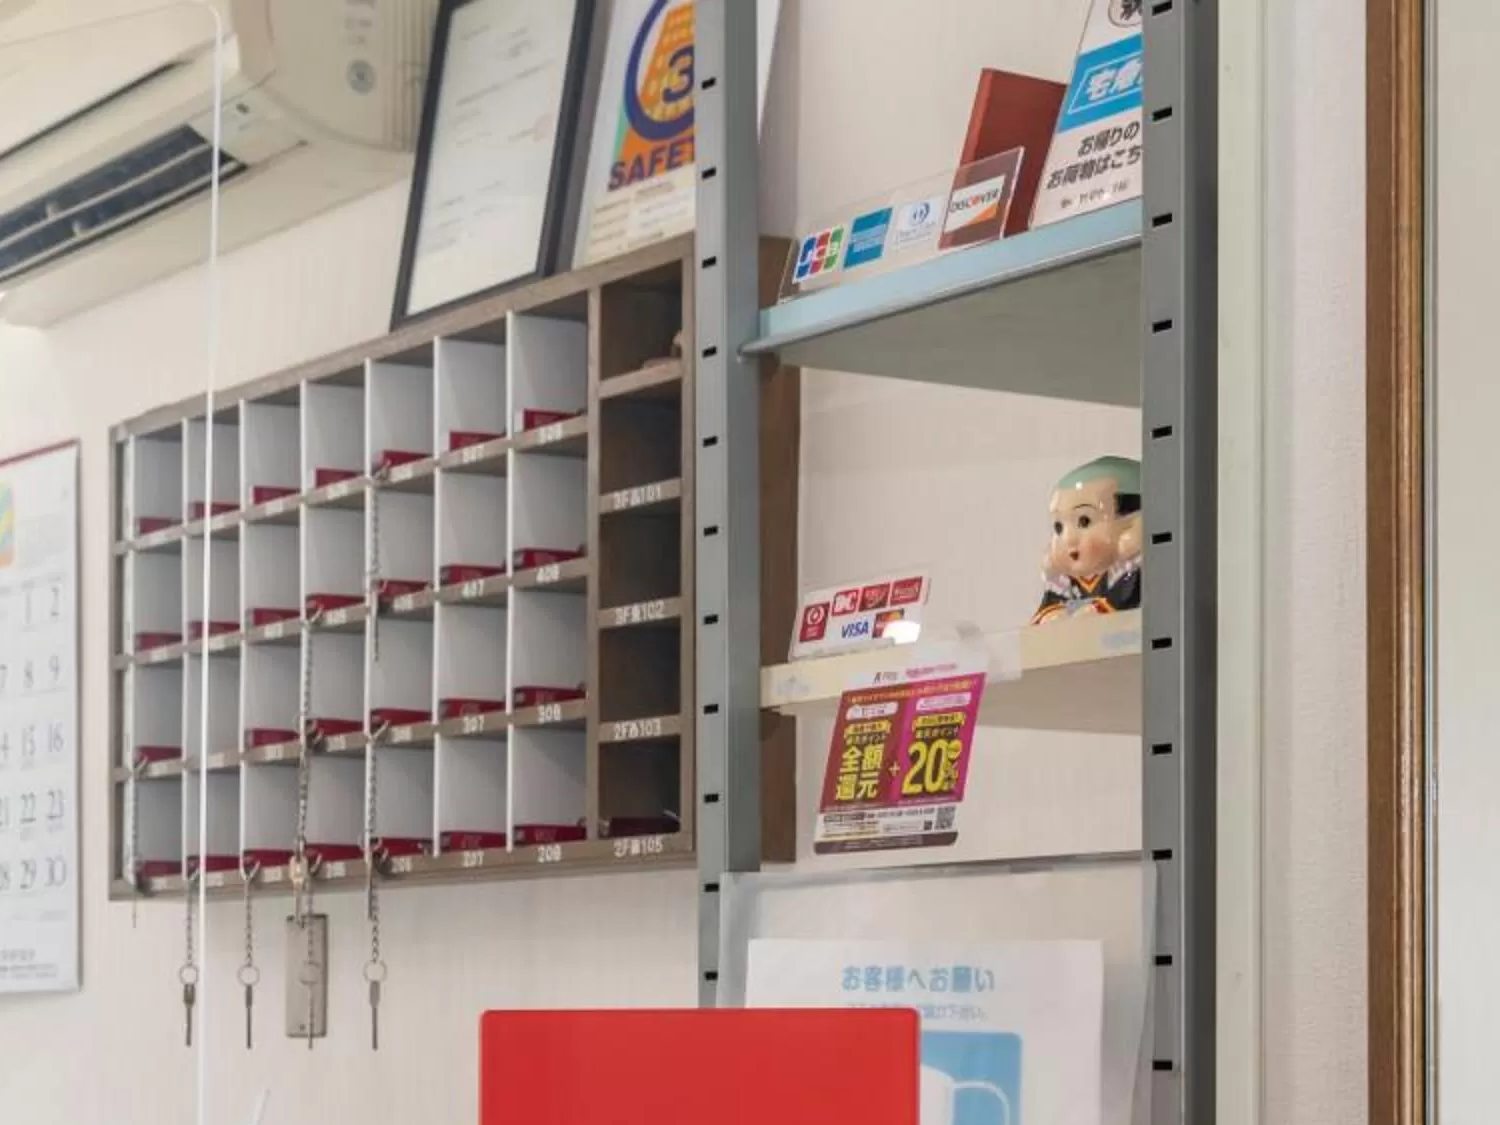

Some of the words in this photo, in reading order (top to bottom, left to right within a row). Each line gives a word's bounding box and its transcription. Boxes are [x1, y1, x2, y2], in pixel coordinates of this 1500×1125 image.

[1078, 121, 1140, 157] お帰りの
[794, 226, 845, 281] JCB
[842, 621, 869, 638] VISA
[841, 965, 995, 993] お客様へお願い
